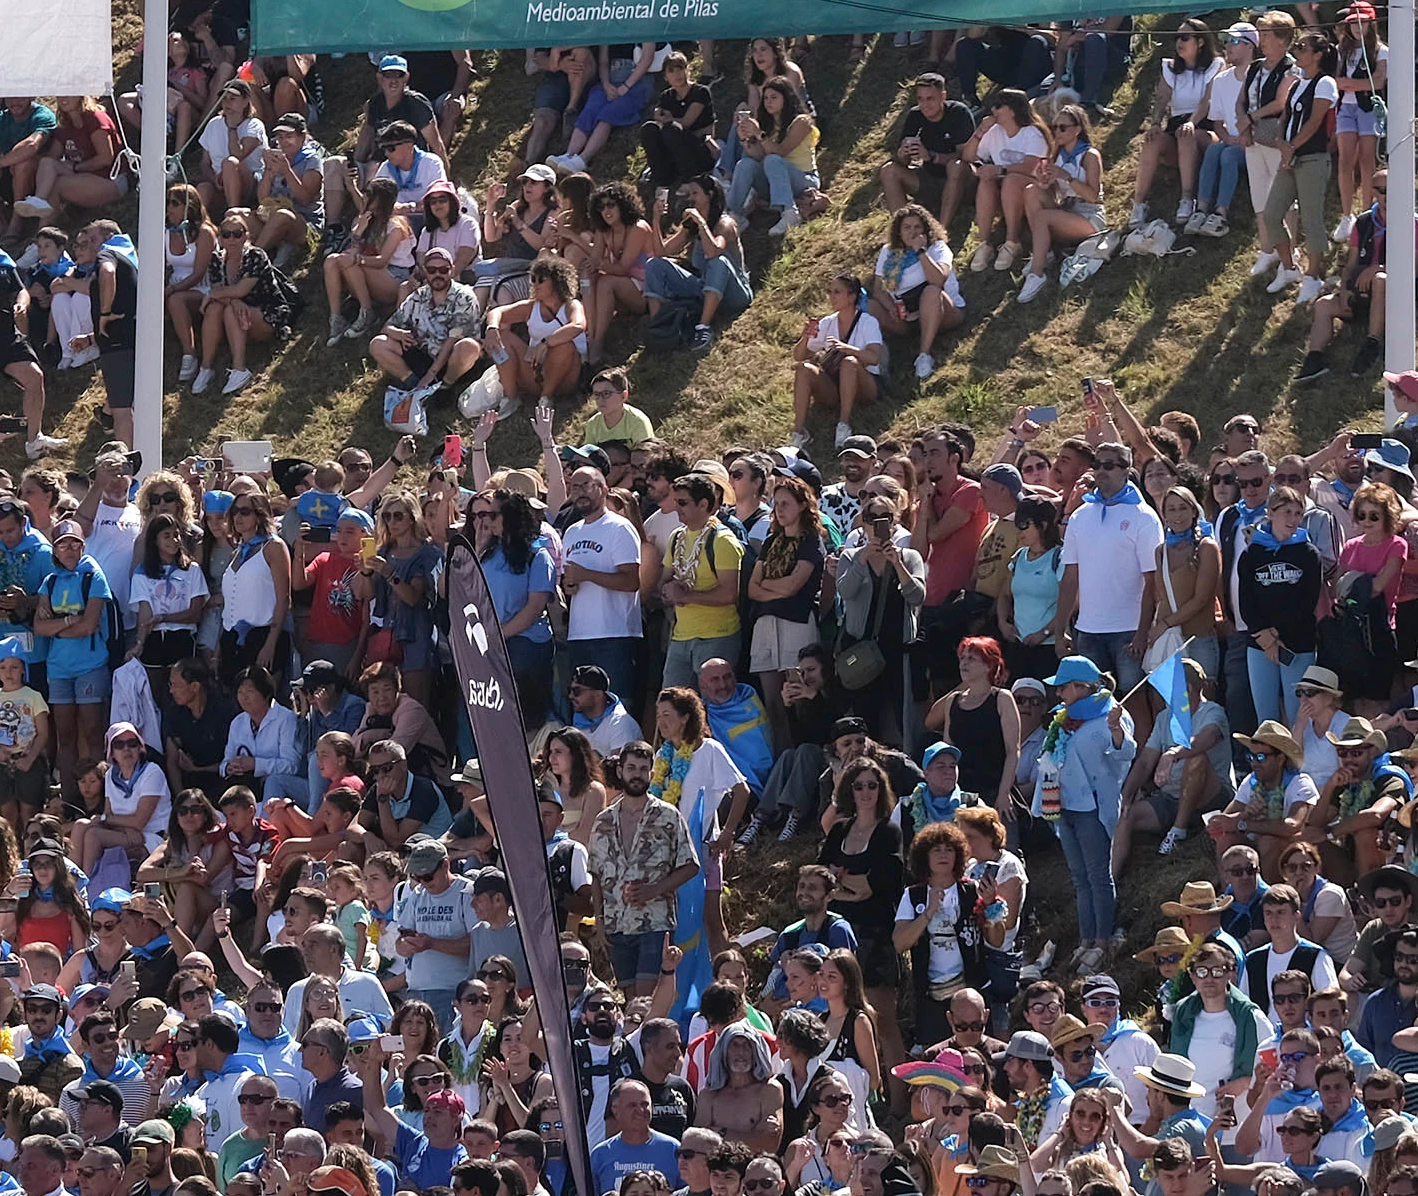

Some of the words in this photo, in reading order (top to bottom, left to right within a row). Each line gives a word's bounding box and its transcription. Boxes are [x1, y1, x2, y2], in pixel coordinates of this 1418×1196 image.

[527, 1, 654, 23] Medioambiental
[660, 2, 678, 18] de
[438, 905, 454, 916] DES
[614, 1161, 655, 1172] Augustiner
